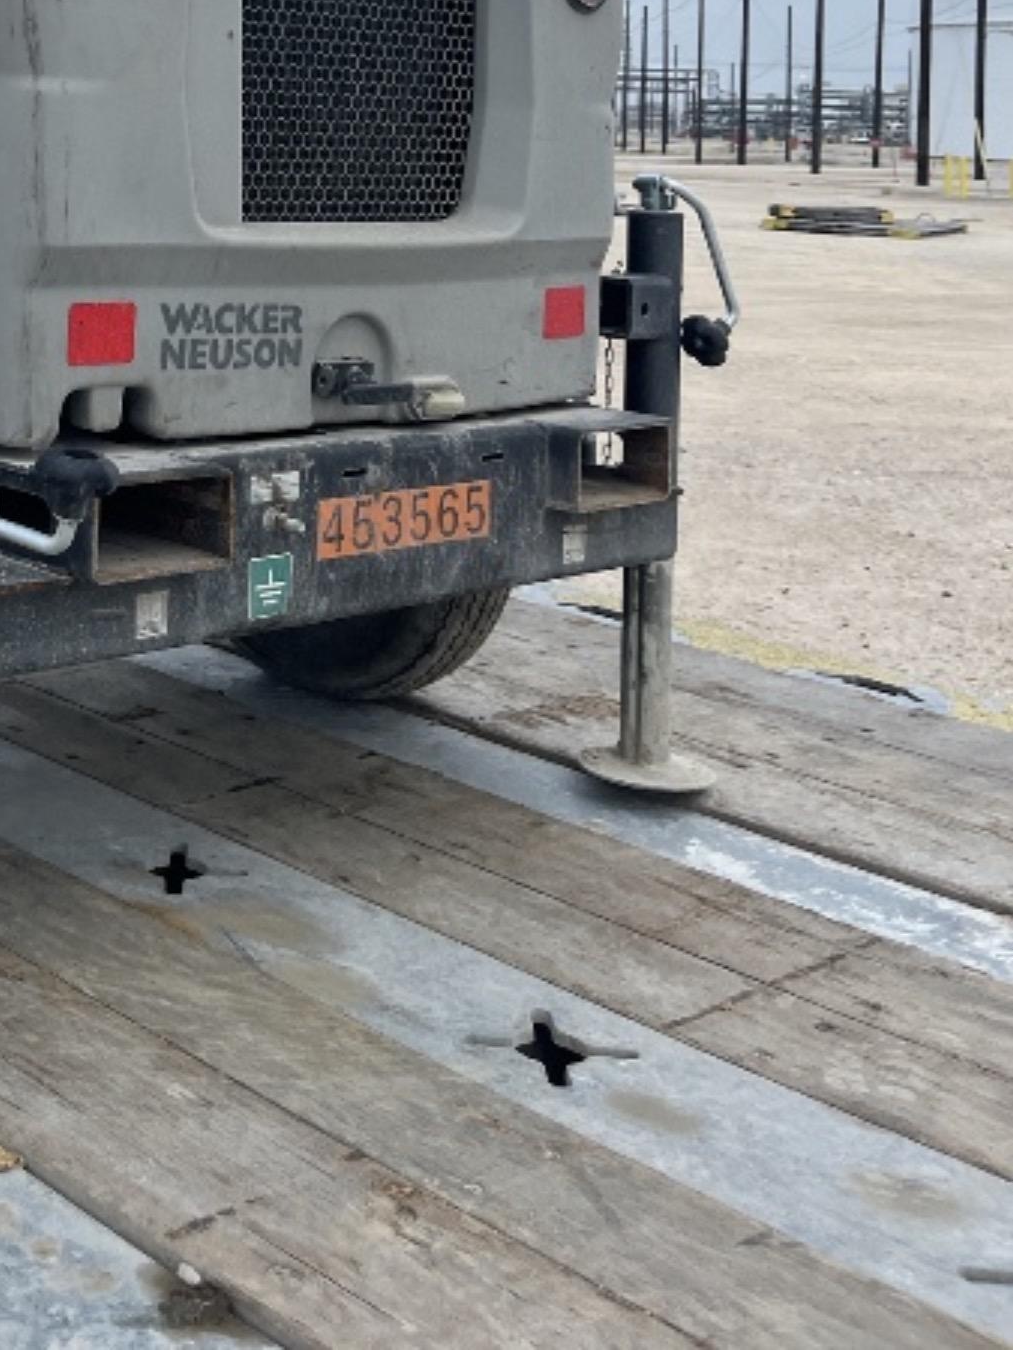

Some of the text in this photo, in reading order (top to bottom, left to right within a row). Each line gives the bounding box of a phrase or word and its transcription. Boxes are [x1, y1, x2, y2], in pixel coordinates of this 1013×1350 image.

[160, 303, 303, 334] WACKER
[160, 338, 301, 370] NEUSON
[321, 484, 486, 552] 453565
